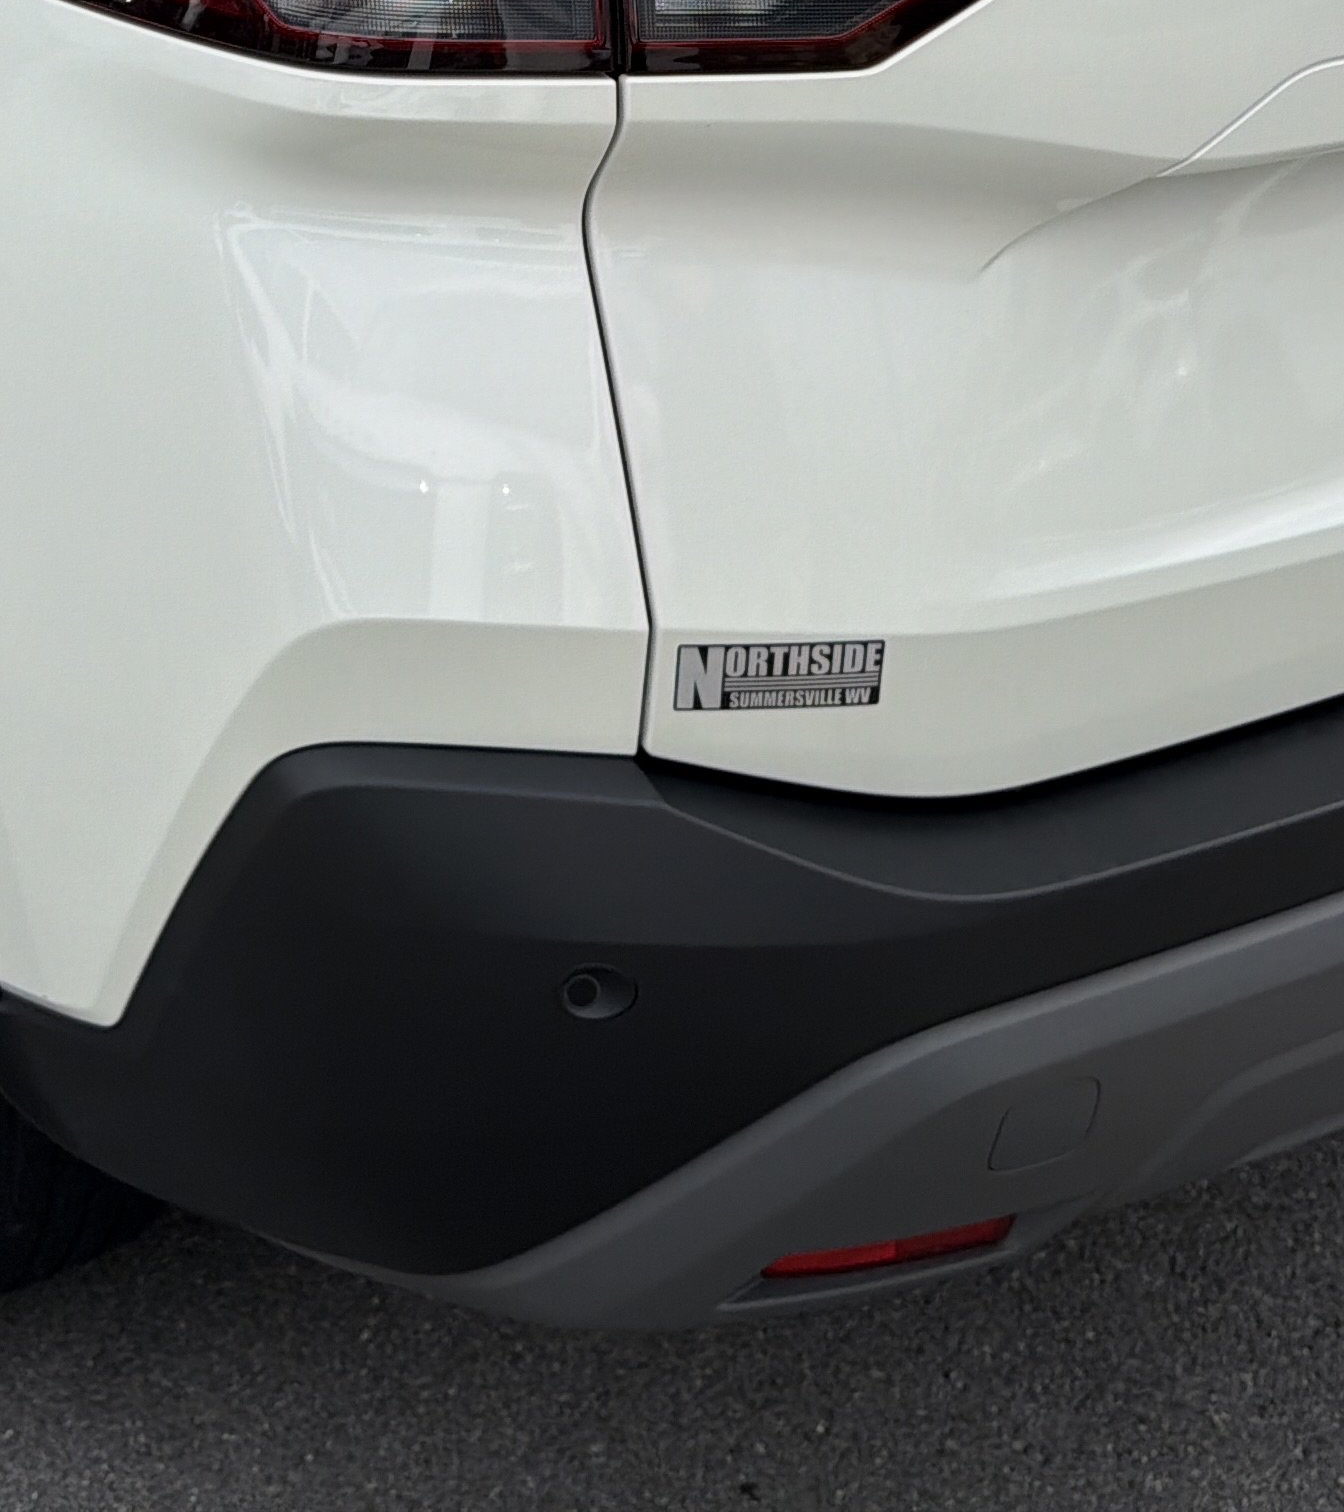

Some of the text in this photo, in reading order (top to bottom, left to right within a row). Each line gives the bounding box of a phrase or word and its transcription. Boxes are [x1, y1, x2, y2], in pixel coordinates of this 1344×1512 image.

[675, 642, 884, 710] NORTHSIDE
[729, 687, 872, 709] SUMMERSVILLE WV
